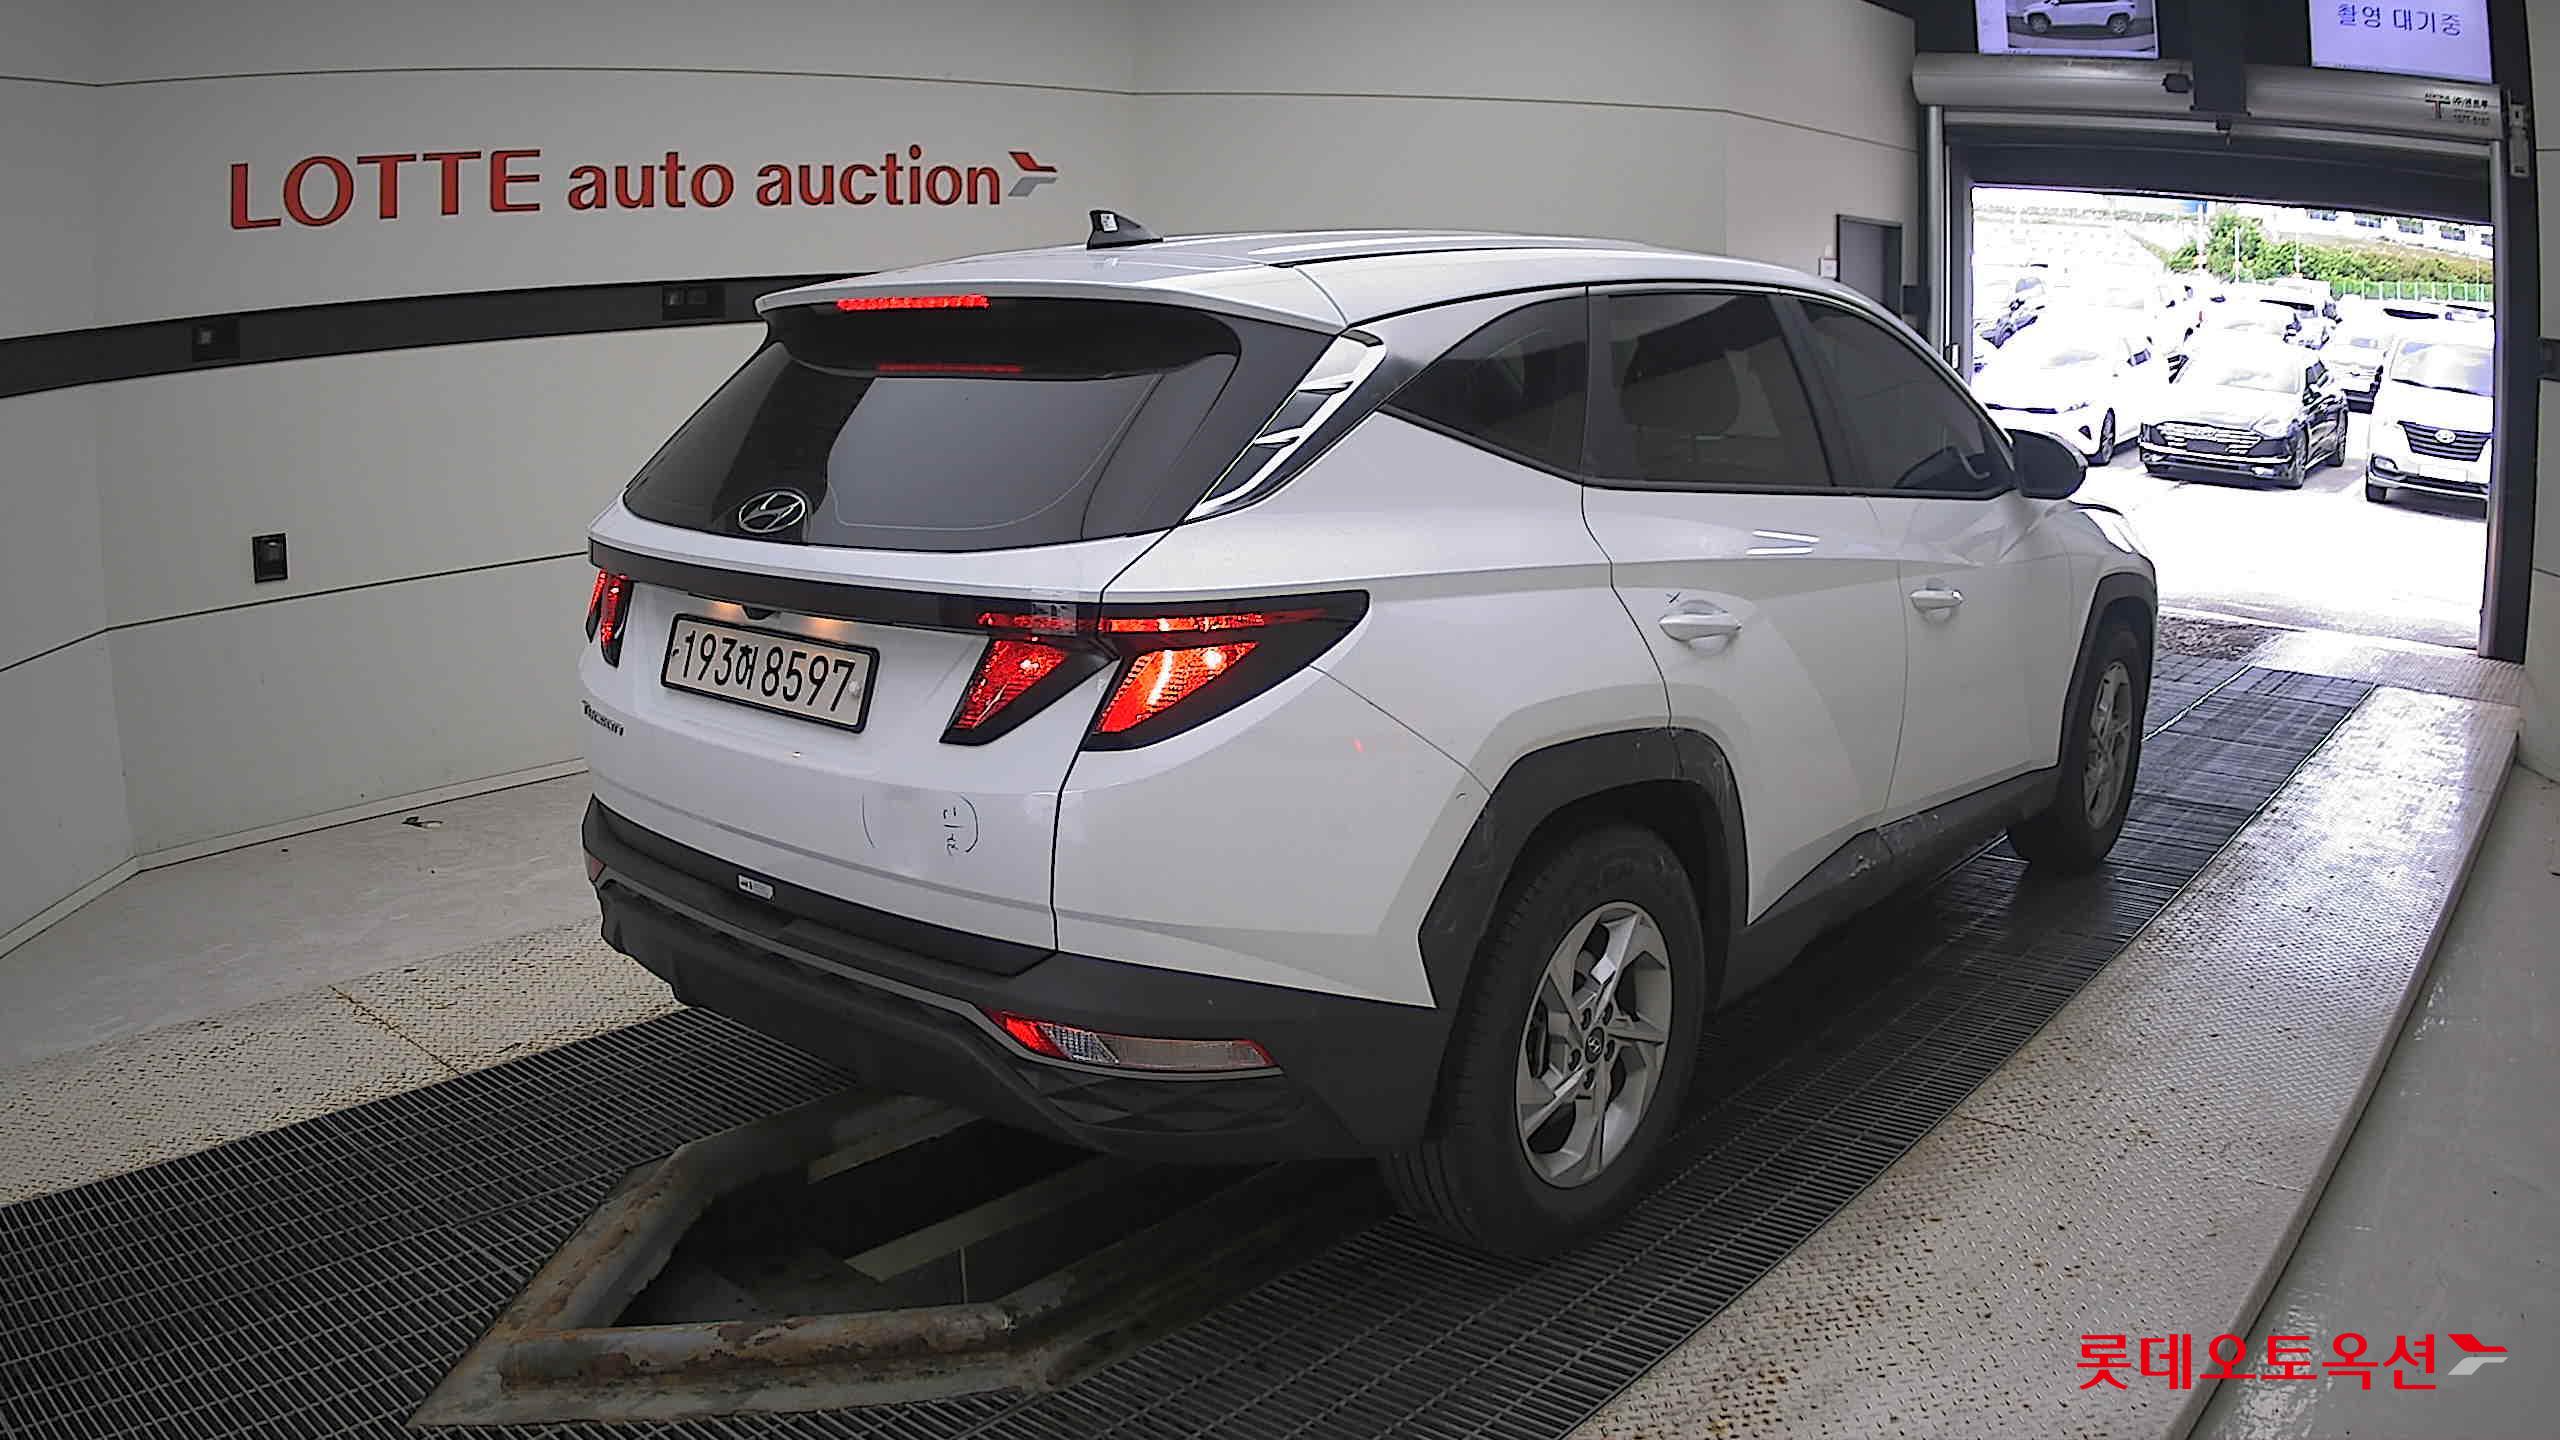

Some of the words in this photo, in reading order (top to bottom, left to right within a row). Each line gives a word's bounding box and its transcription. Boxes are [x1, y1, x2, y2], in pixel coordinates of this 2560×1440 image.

[2338, 3, 2382, 28] 촬영
[2393, 8, 2461, 37] 대기중
[230, 149, 541, 230] LOTTE
[567, 151, 735, 211] auto
[756, 144, 1001, 206] auction
